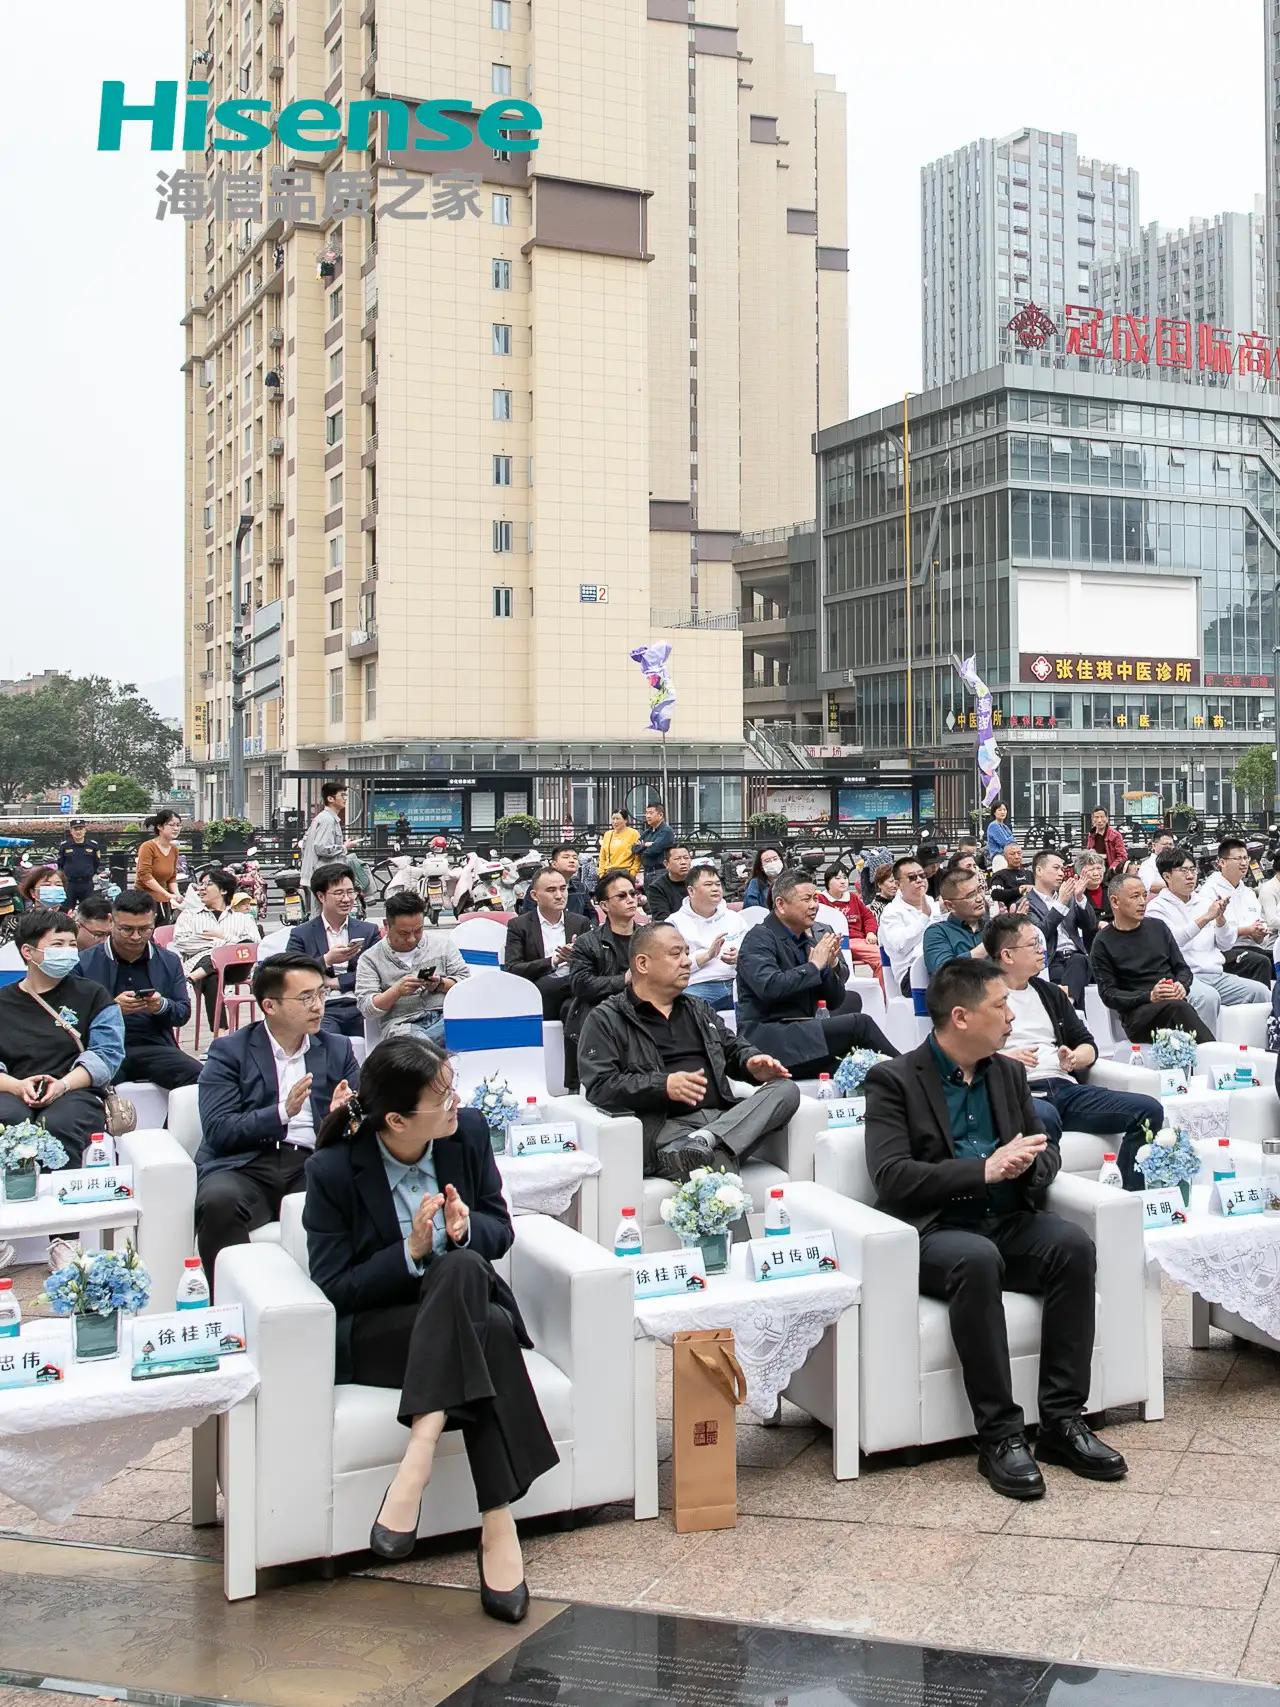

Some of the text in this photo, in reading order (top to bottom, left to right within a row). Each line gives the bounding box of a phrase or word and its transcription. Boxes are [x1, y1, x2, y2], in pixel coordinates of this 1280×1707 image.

[599, 587, 606, 601] 2
[1055, 658, 1192, 683] 张佳琪中医诊所
[957, 709, 1003, 729] 中医所
[62, 796, 71, 810] P
[237, 949, 250, 959] 15
[771, 1246, 820, 1265] 甘传明
[636, 1264, 688, 1285] 徐桂萍
[158, 1321, 223, 1346] 徐桂萍
[0, 1351, 41, 1372] 忠伟
